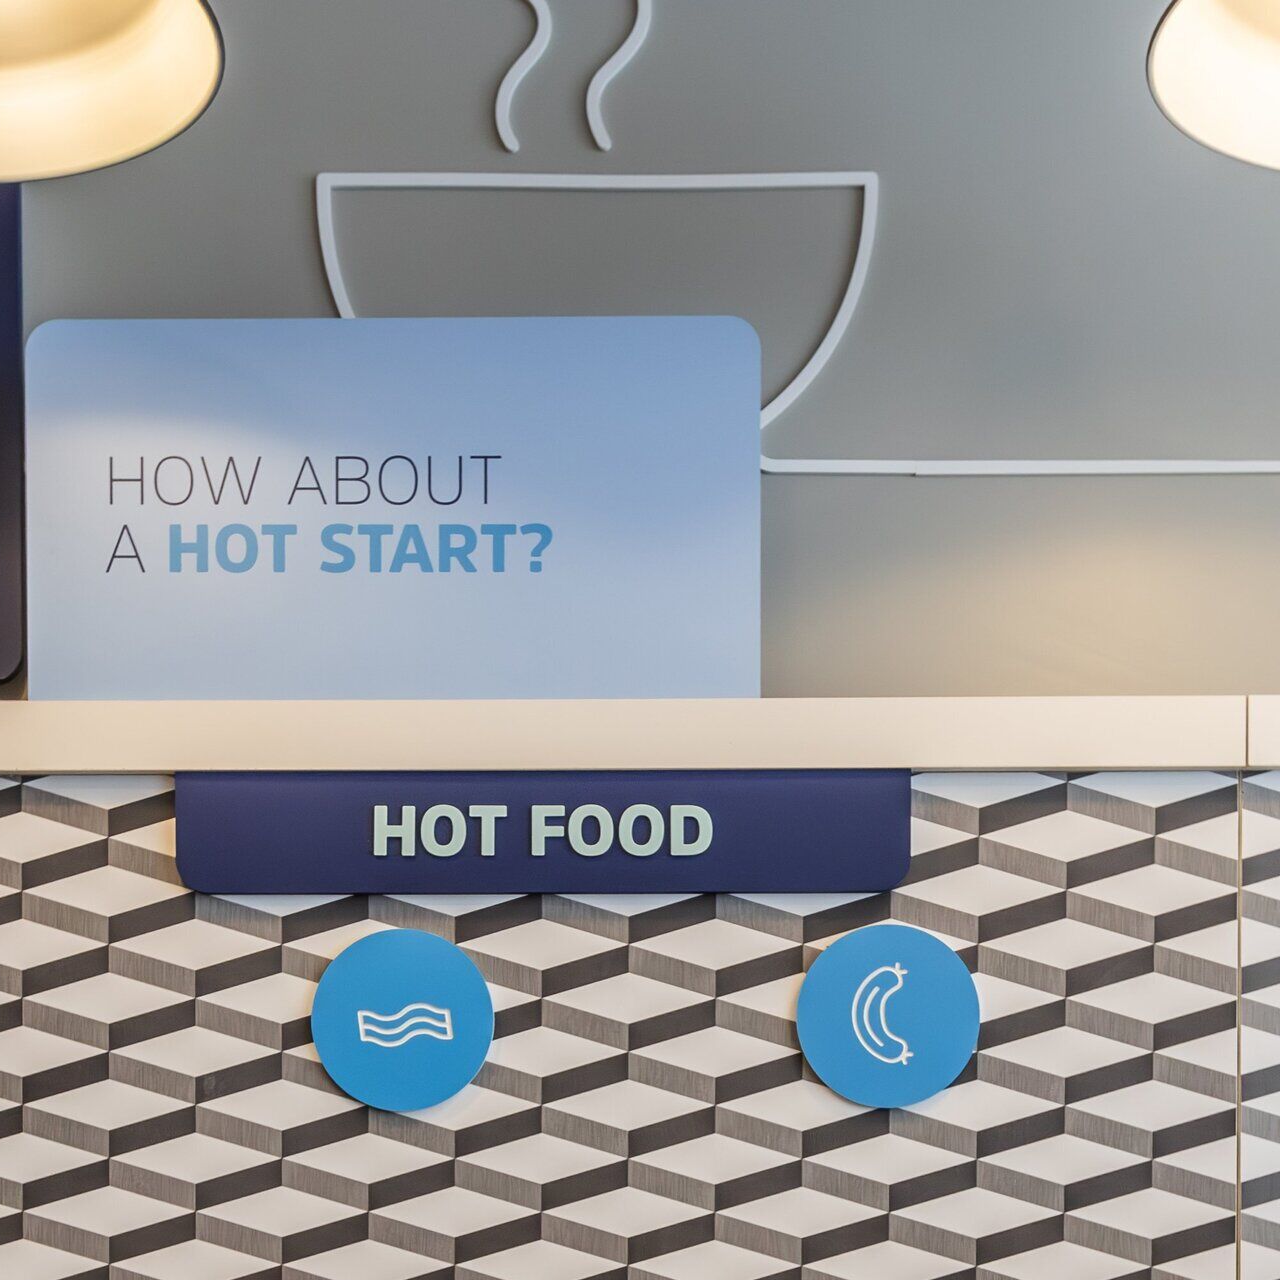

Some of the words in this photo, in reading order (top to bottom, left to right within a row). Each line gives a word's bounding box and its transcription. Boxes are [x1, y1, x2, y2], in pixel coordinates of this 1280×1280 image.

[106, 455, 262, 507] HOW
[287, 454, 503, 506] ABOUT
[106, 523, 146, 574] A
[168, 523, 297, 574] HOT
[320, 523, 554, 574] START?
[373, 803, 507, 857] HOT
[530, 803, 714, 857] FOOD
